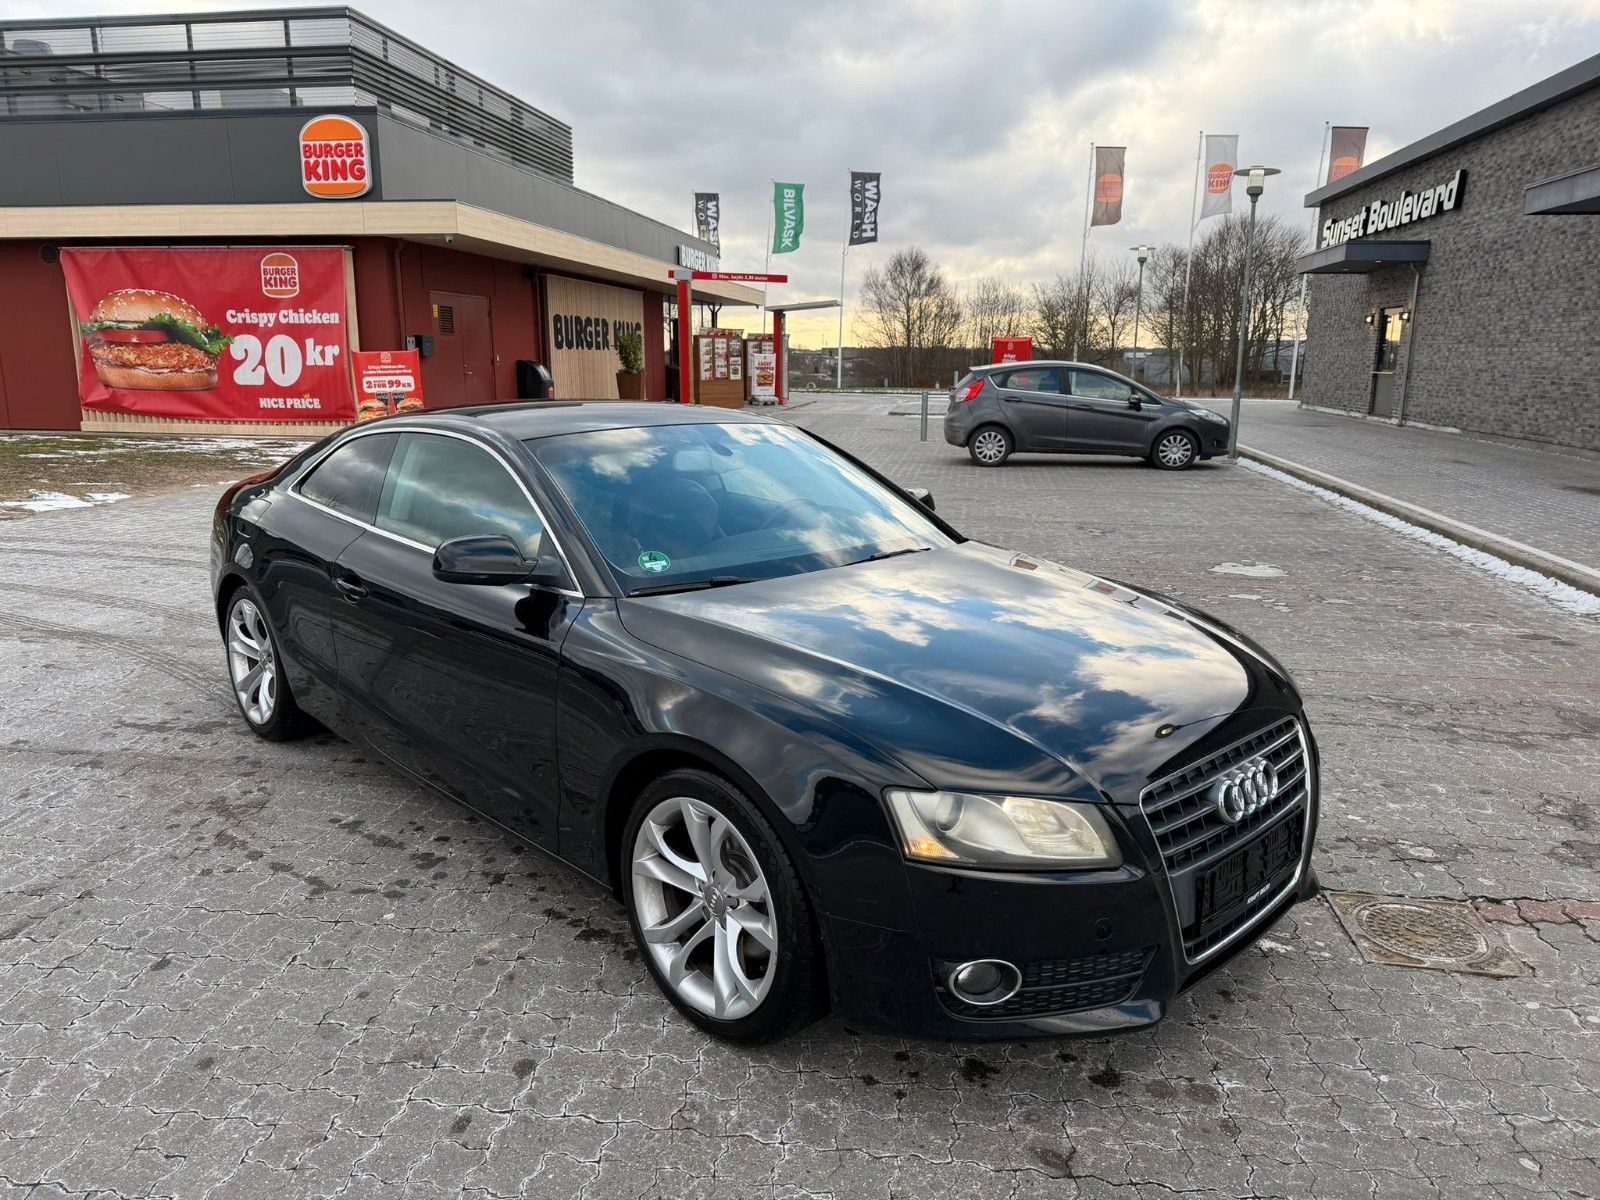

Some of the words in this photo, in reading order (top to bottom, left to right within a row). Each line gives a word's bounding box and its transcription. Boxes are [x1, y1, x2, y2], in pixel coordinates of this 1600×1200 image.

[303, 143, 365, 158] BURGER
[304, 159, 366, 181] KING
[698, 200, 706, 240] WOR
[707, 201, 718, 246] WAS
[782, 188, 796, 248] BILVASK
[853, 180, 862, 239] WORLD
[862, 181, 878, 237] WASH
[1321, 206, 1367, 249] Sunset
[1367, 169, 1461, 235] Boulevard
[263, 267, 297, 277] BURGER
[681, 244, 705, 272] BURGER
[264, 277, 298, 288] KING
[226, 308, 277, 327] Crispy
[279, 308, 340, 324] Chicken
[553, 314, 609, 350] BURGER
[230, 334, 302, 387] 20
[305, 338, 340, 366] kr
[366, 380, 372, 388] 2
[387, 380, 400, 388] 99
[260, 398, 285, 409] NICE
[286, 398, 321, 409] PRICE
